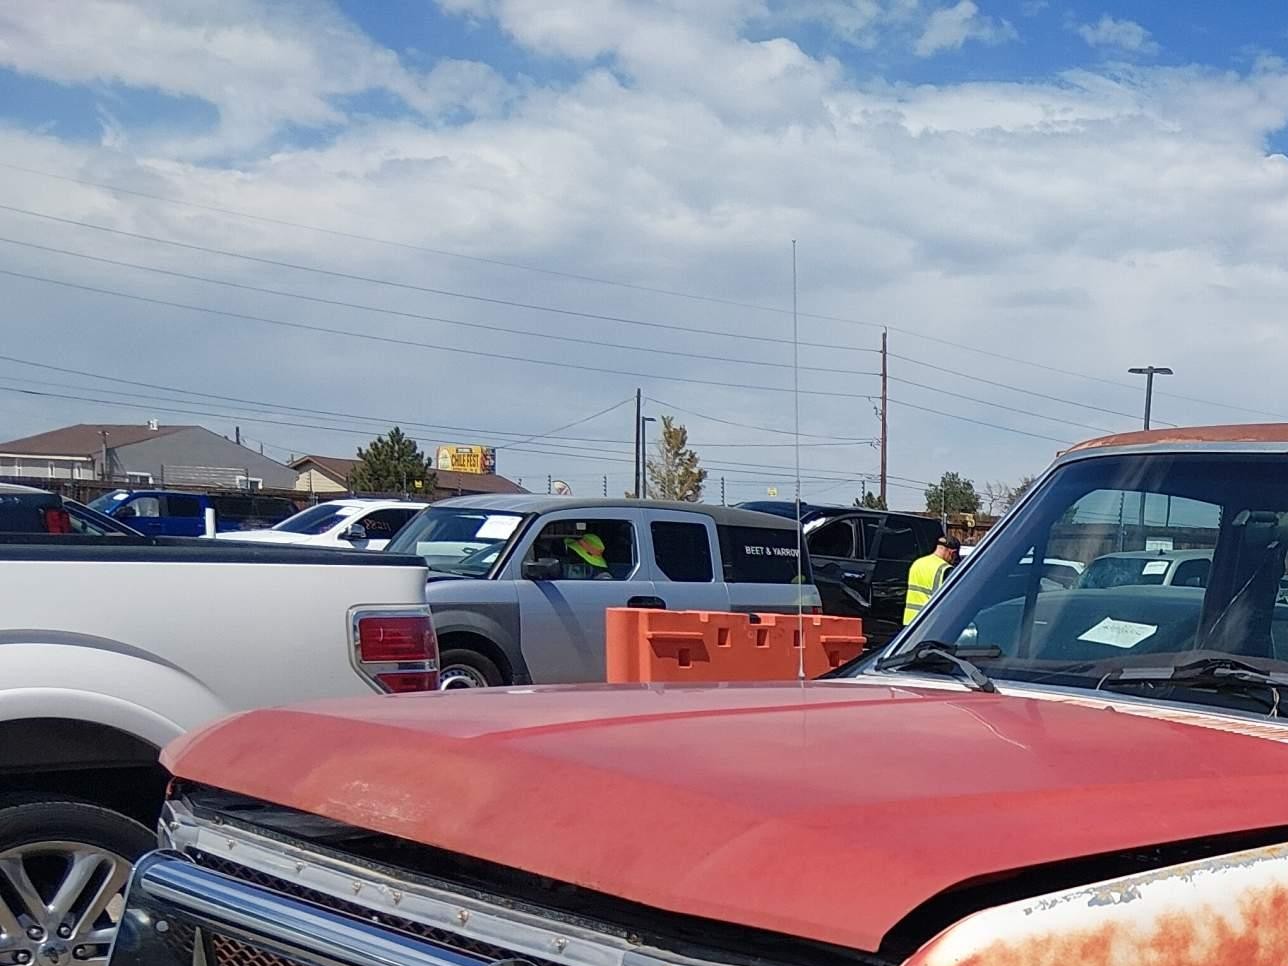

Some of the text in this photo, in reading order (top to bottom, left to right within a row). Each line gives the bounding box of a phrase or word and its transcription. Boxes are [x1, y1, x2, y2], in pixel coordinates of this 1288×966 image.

[451, 453, 480, 468] CHILE FEST
[745, 546, 764, 555] BEET
[766, 547, 771, 556] &
